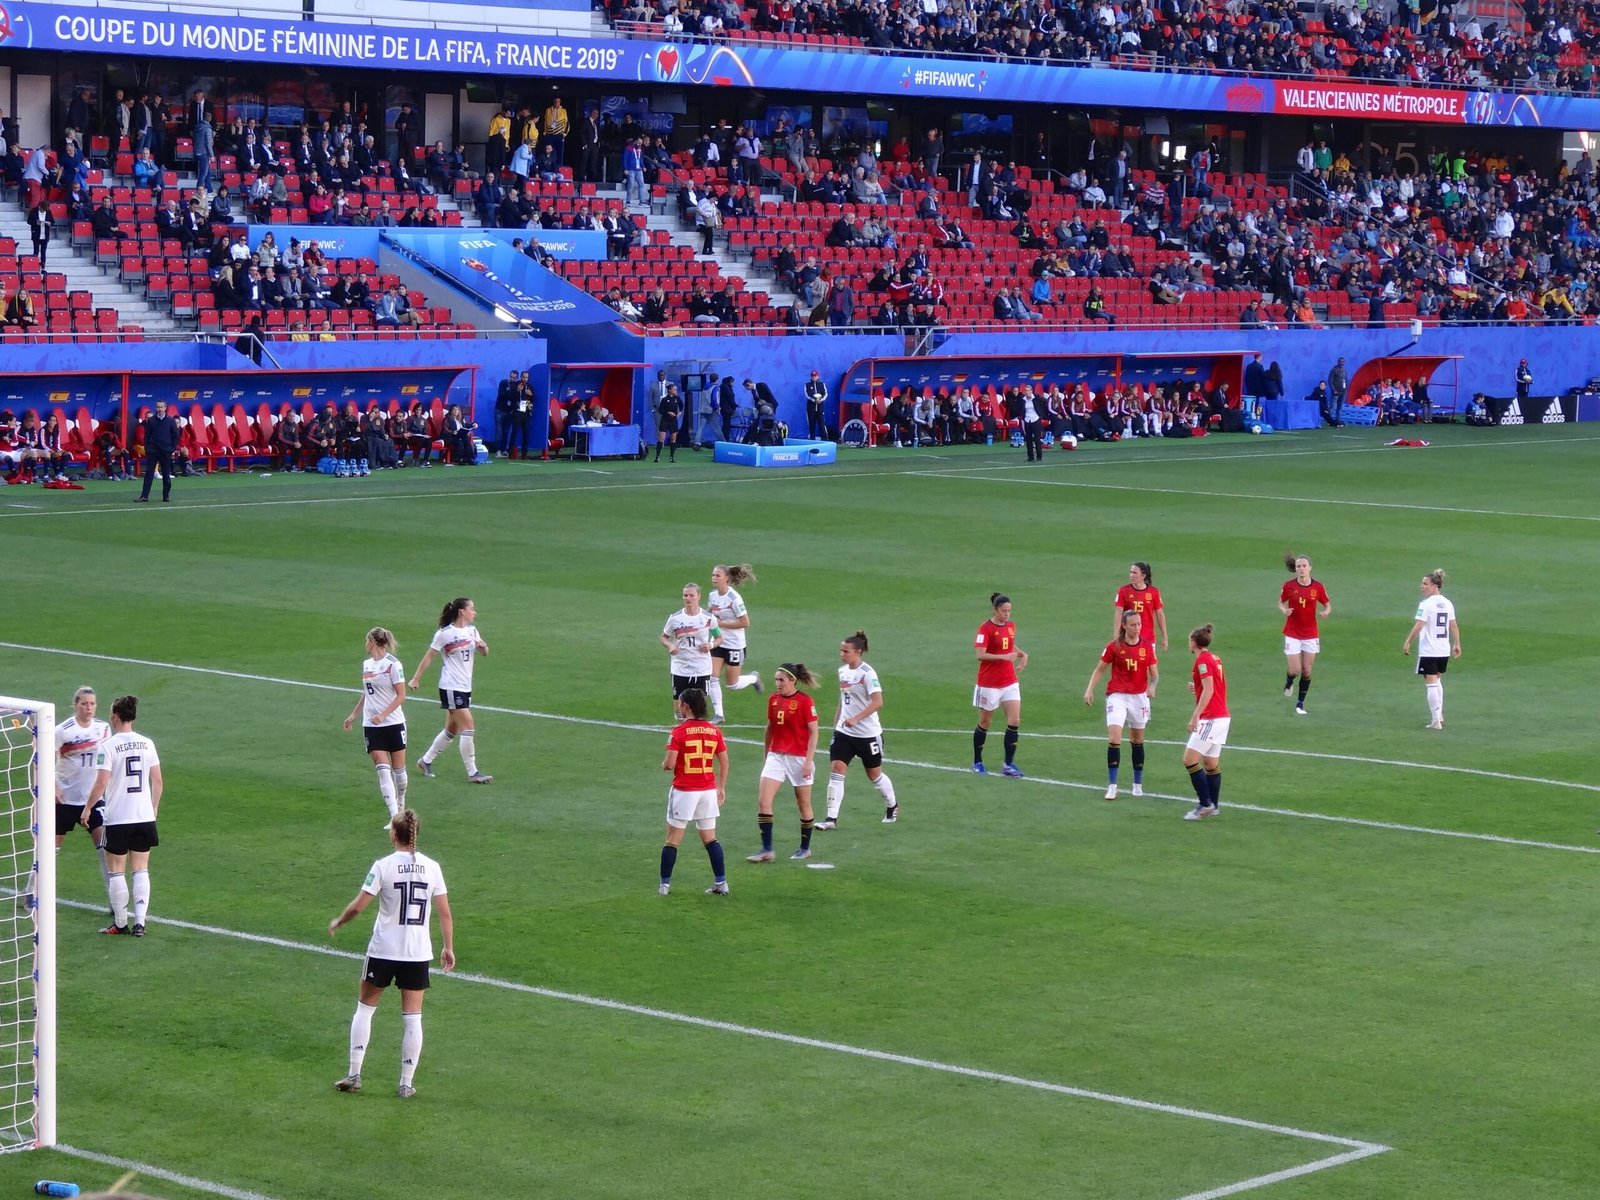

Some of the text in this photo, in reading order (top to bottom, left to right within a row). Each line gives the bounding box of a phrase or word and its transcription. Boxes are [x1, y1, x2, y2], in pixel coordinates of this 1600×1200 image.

[55, 15, 136, 44] COUPE
[143, 21, 175, 46] DU
[183, 25, 267, 52] MONDE
[271, 26, 377, 59] FÉMININE
[383, 36, 409, 60] DE
[415, 38, 441, 61] LA
[445, 40, 491, 67] FIFA,
[496, 43, 572, 69] FRANCE
[914, 70, 975, 88] #FIFAWWC
[1283, 89, 1458, 116] VALENCIENNES MÉTROPOLE
[459, 240, 497, 250] FIFA
[1500, 415, 1524, 425] adidas
[1542, 414, 1565, 424] adidas
[1133, 600, 1144, 613] 15
[1299, 596, 1307, 608] 4
[1436, 612, 1448, 639] 9
[687, 636, 697, 648] 11
[461, 649, 470, 662] 13
[1125, 658, 1138, 672] 14
[776, 710, 785, 725] 9
[115, 741, 149, 753] HEGERING
[869, 741, 880, 756] 6
[81, 752, 94, 768] 17
[684, 739, 719, 774] 22
[125, 755, 143, 793] 5
[397, 864, 426, 875] GWINN
[393, 881, 429, 927] 15
